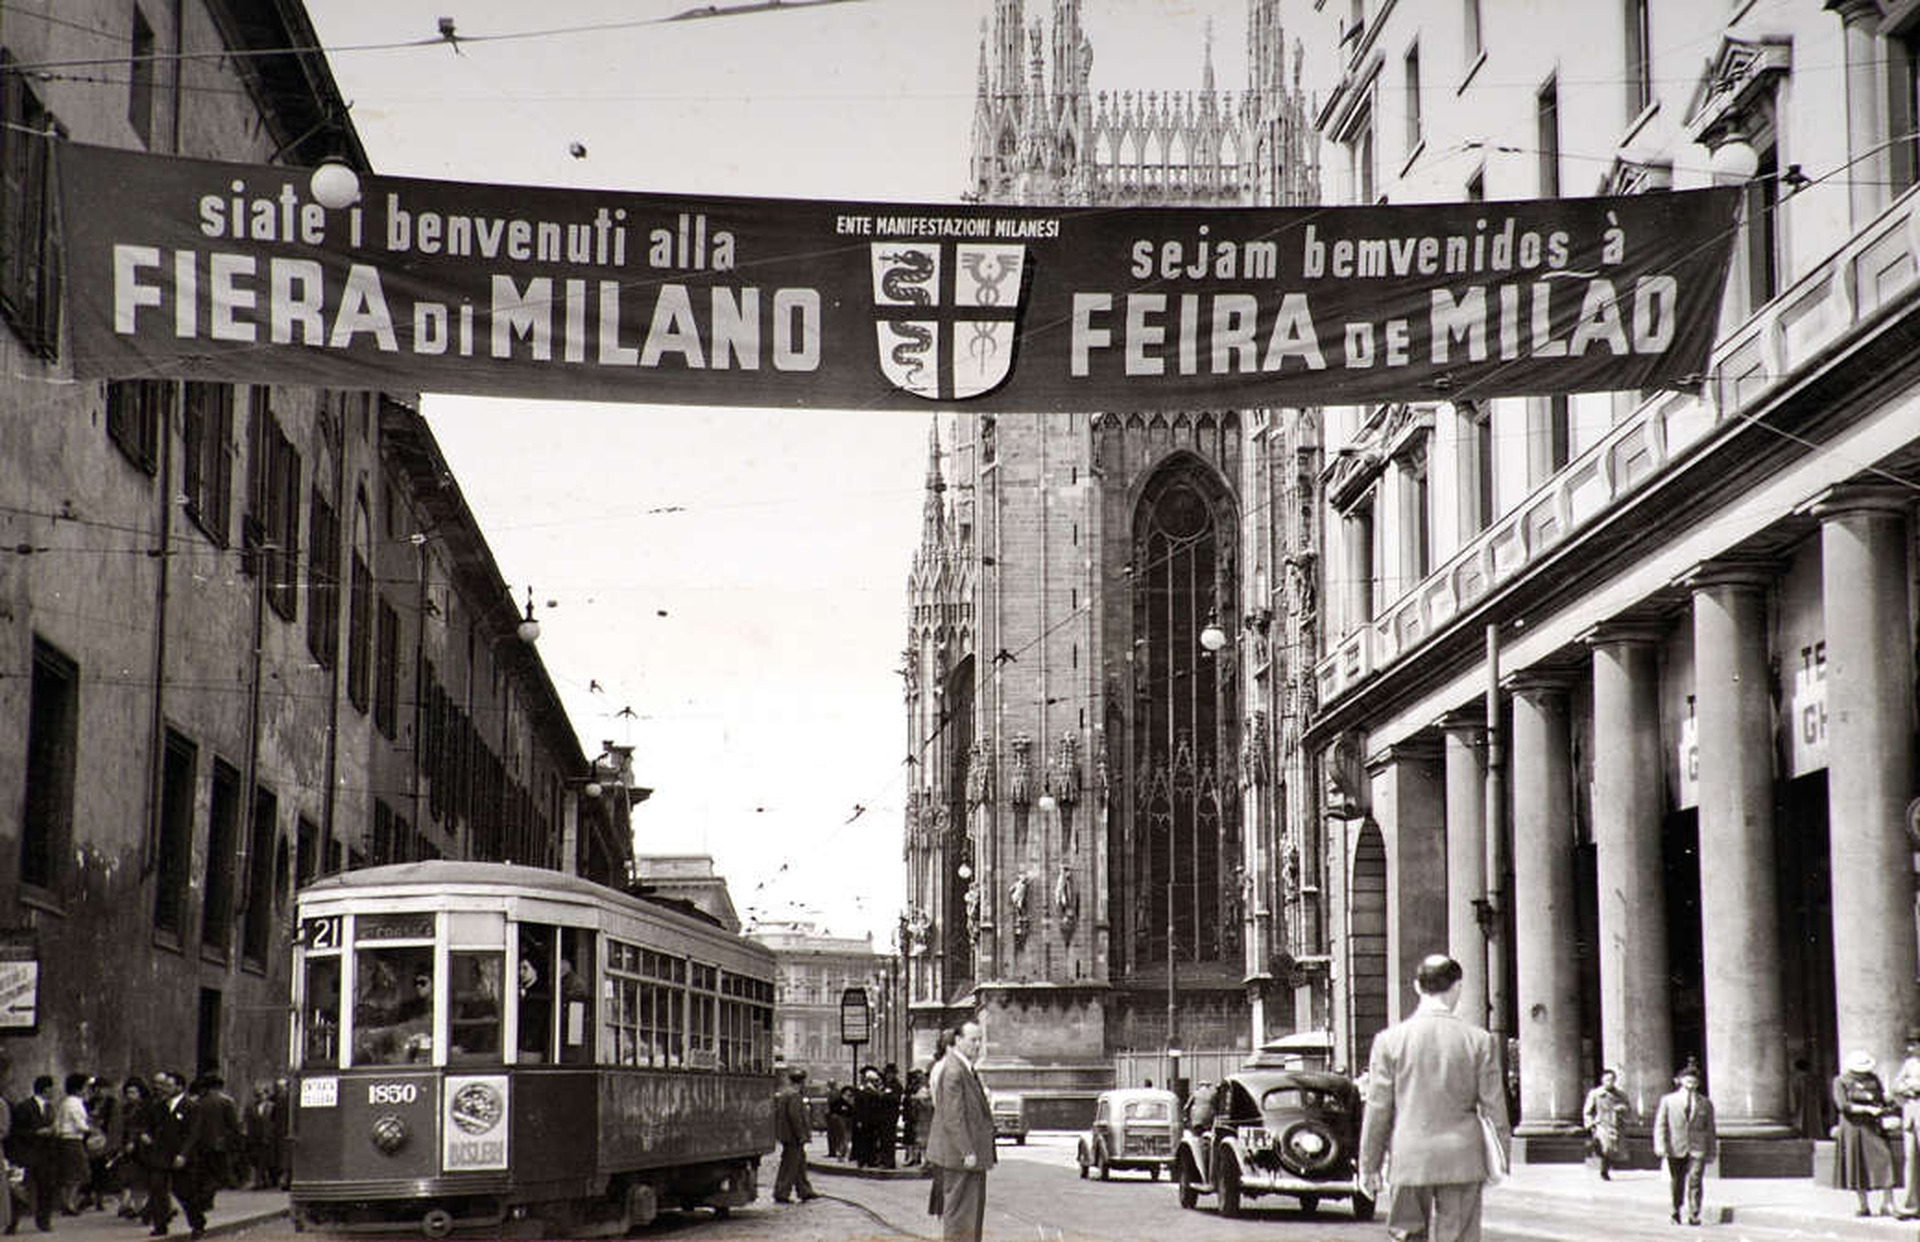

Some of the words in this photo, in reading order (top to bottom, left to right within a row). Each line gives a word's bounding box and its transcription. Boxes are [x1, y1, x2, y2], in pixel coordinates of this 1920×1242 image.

[201, 179, 325, 244] siate
[387, 192, 627, 266] benvenuti
[649, 213, 735, 271] alla
[836, 216, 872, 234] ENTE
[876, 217, 990, 236] MANIFESTAZIONI
[995, 220, 1060, 237] MILANESI
[1131, 226, 1277, 280] sejam
[1304, 218, 1569, 279] bemvenidos
[113, 244, 399, 352] FIERA
[490, 274, 821, 372] MILANO
[1071, 292, 1327, 376] FEIRA
[1344, 319, 1410, 369] DE
[313, 919, 339, 948] 21
[368, 1083, 417, 1104] 1850
